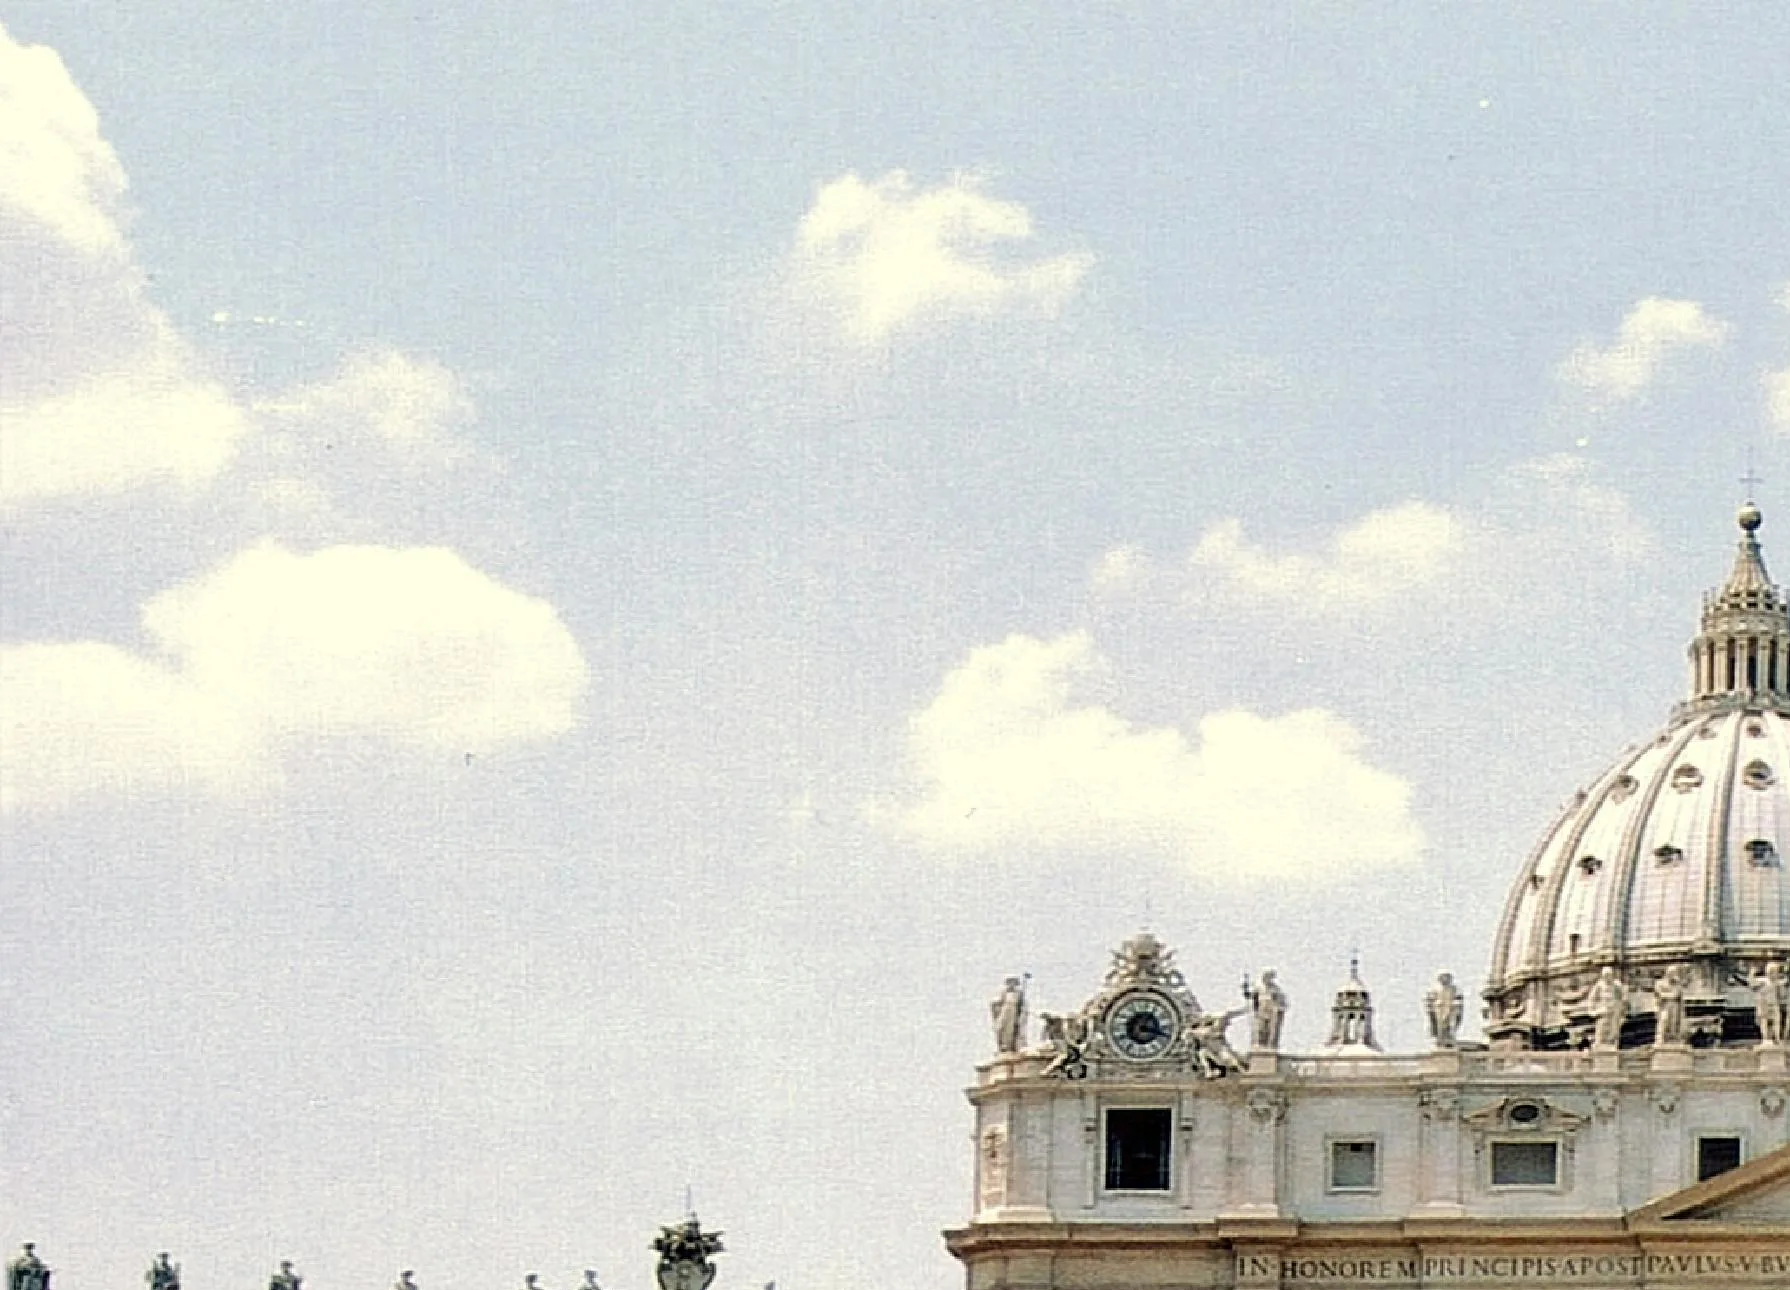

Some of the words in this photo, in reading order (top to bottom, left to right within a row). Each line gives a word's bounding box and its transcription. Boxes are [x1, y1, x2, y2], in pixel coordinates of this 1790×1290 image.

[1239, 1257, 1269, 1277] IN
[1281, 1260, 1417, 1279] HONOREM
[1424, 1256, 1557, 1277] PRINCIPIS
